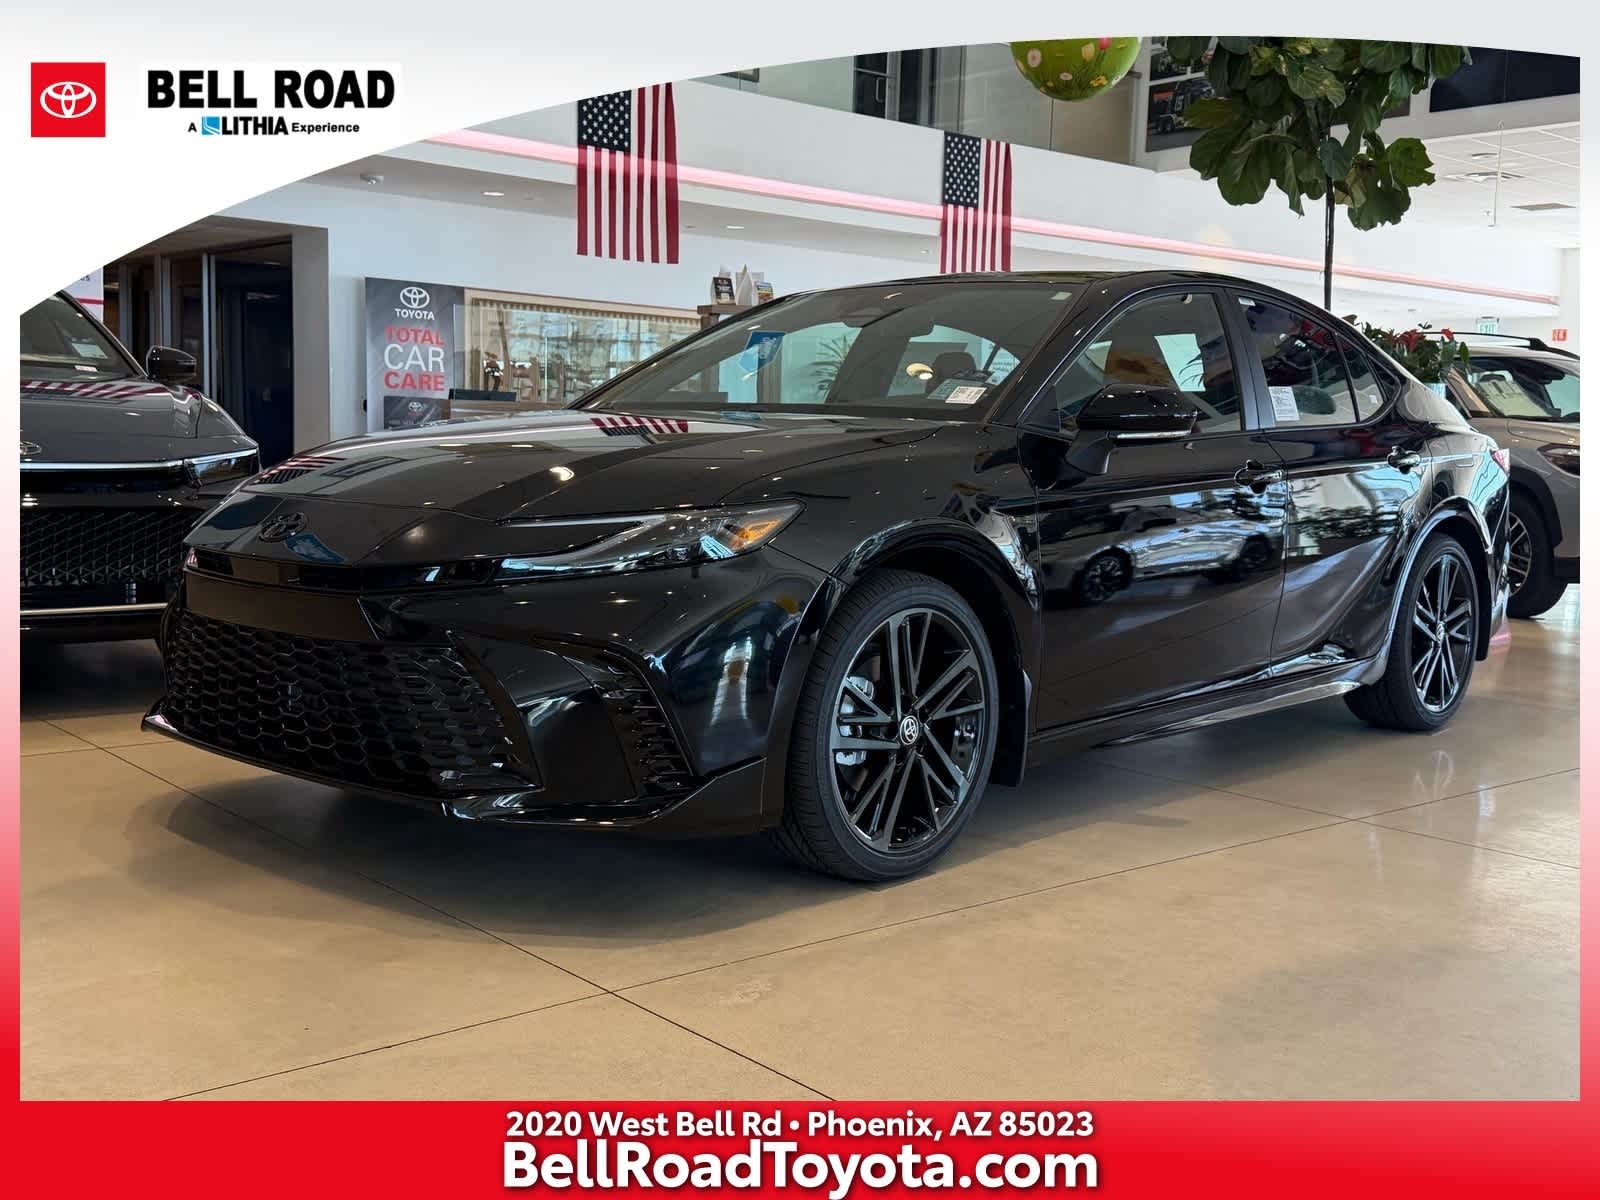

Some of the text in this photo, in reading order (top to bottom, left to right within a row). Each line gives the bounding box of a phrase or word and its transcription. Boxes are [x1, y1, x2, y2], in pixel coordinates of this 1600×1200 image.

[394, 308, 436, 321] TOYOTA
[385, 325, 445, 346] TOTAL
[384, 343, 445, 373] CAR
[384, 371, 445, 392] CARE
